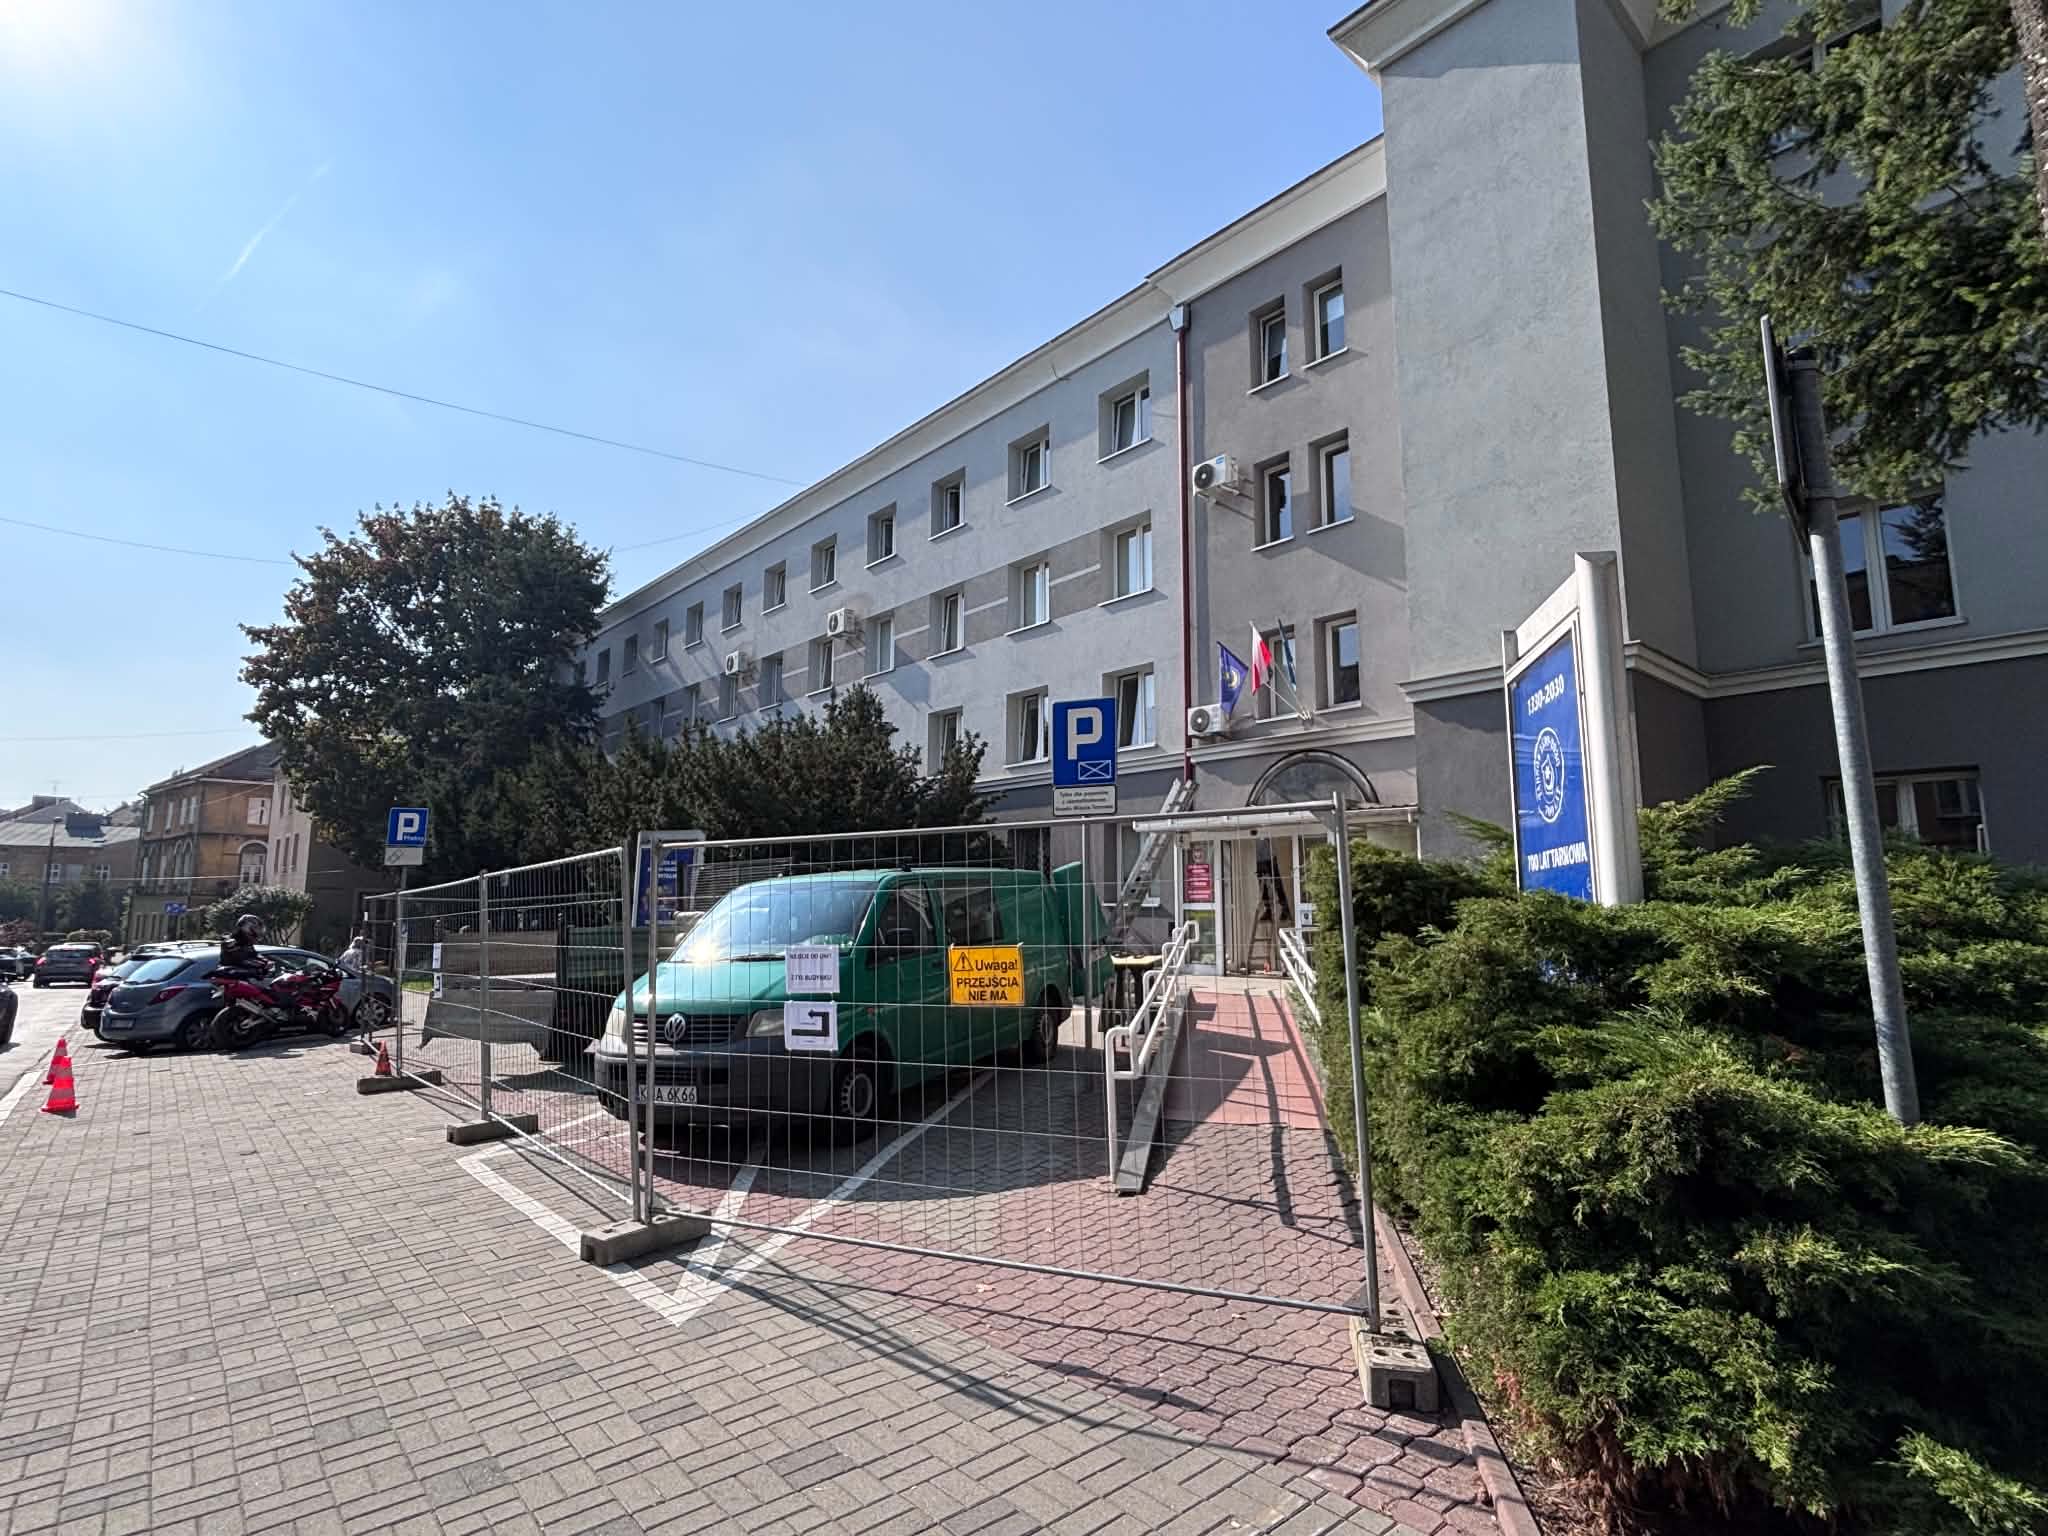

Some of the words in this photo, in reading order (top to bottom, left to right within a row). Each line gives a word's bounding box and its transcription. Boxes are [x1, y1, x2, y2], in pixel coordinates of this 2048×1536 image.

[1528, 674, 1565, 717] 1330-2030
[1067, 706, 1103, 761] P
[396, 812, 420, 841] P
[1528, 853, 1539, 872] 700
[1540, 849, 1551, 870] LAT
[975, 959, 1019, 973] Uwaga!
[956, 974, 1019, 989] PRZEJŚCIA
[969, 991, 987, 1001] NIE
[990, 990, 1008, 1001] MA
[640, 1087, 664, 1102] KA
[667, 1087, 695, 1102] 6K66
